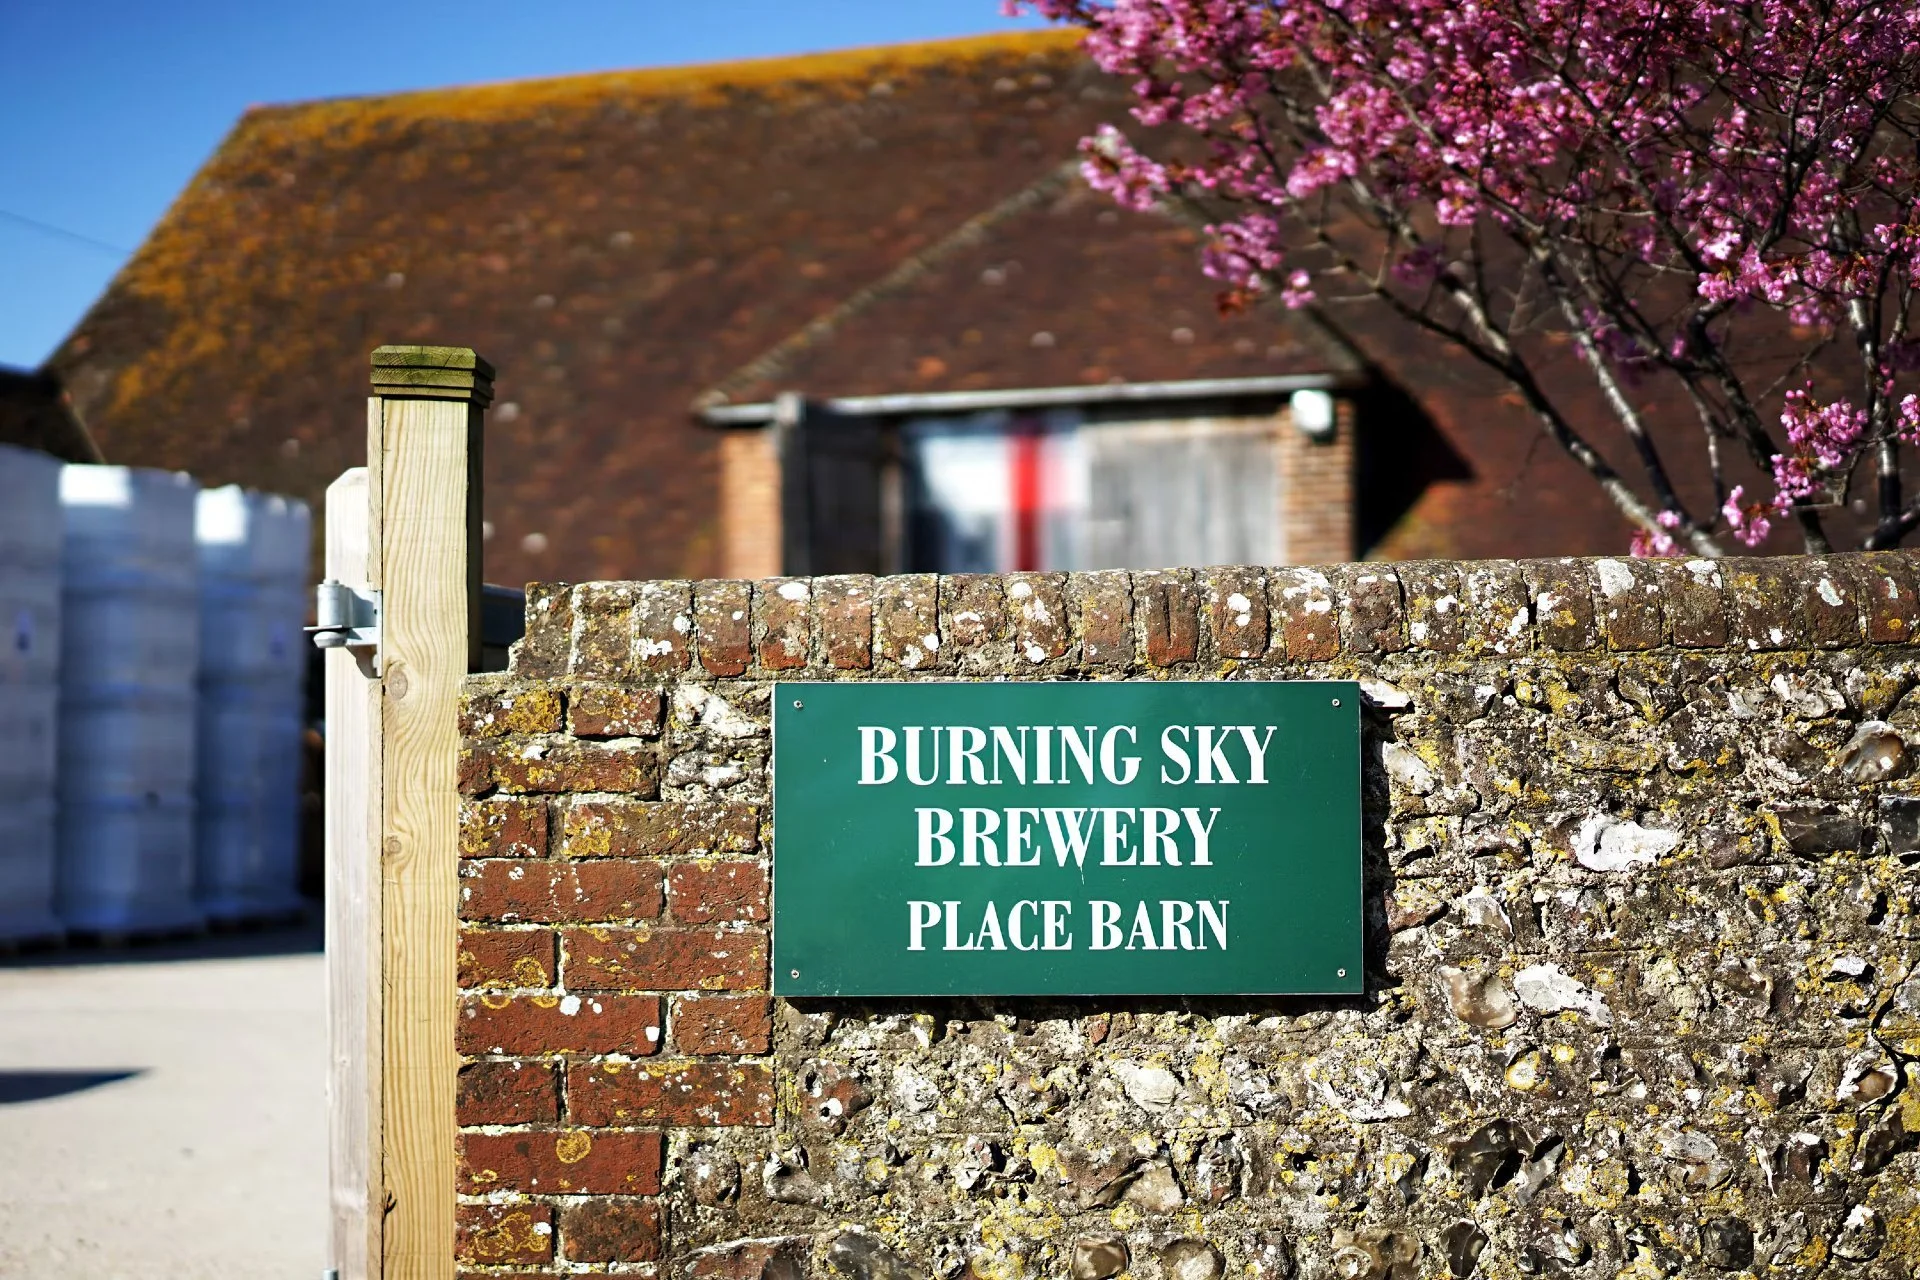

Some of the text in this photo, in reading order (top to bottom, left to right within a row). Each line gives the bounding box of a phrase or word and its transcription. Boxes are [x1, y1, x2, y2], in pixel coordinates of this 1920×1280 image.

[857, 725, 1278, 786] BURNING SKY
[914, 807, 1222, 868] BREWERY
[906, 900, 1230, 951] PLACE BARN
